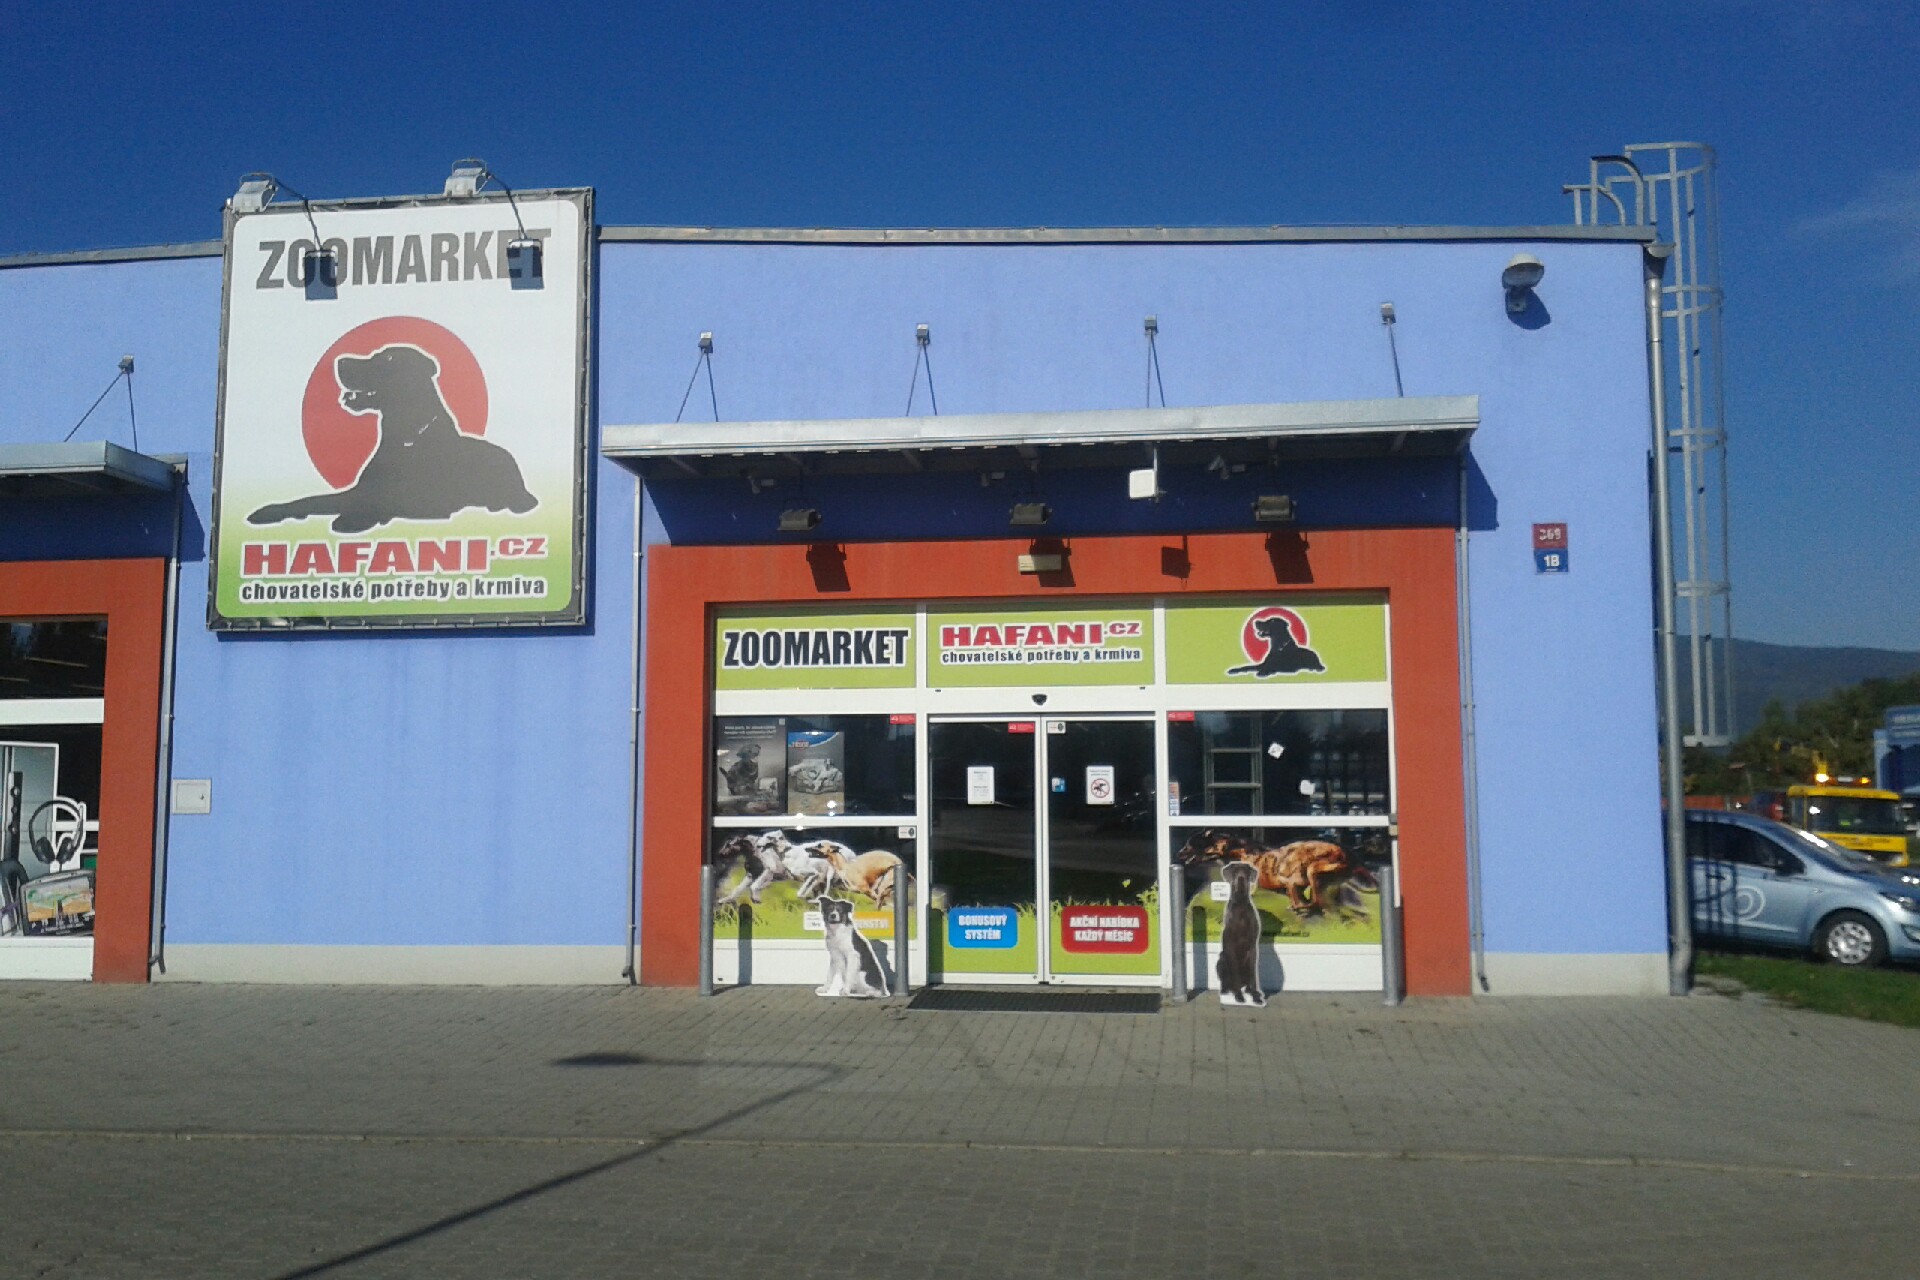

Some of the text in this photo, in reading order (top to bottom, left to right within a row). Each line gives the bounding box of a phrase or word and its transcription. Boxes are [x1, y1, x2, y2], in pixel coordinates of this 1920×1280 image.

[256, 228, 551, 289] ZOOMARKET
[242, 577, 545, 600] chovatelské potřeby a krmiva
[724, 630, 909, 667] ZOOMARKET
[942, 648, 1140, 663] chovatelské potřeby a krmiva
[958, 914, 1007, 926] BONUSOVÝ
[1069, 915, 1140, 928] AKČNÍ NABÍDKA
[965, 927, 1001, 940] SYSTÉM
[1074, 929, 1134, 942] KAŽDÝ MĚSÍC
